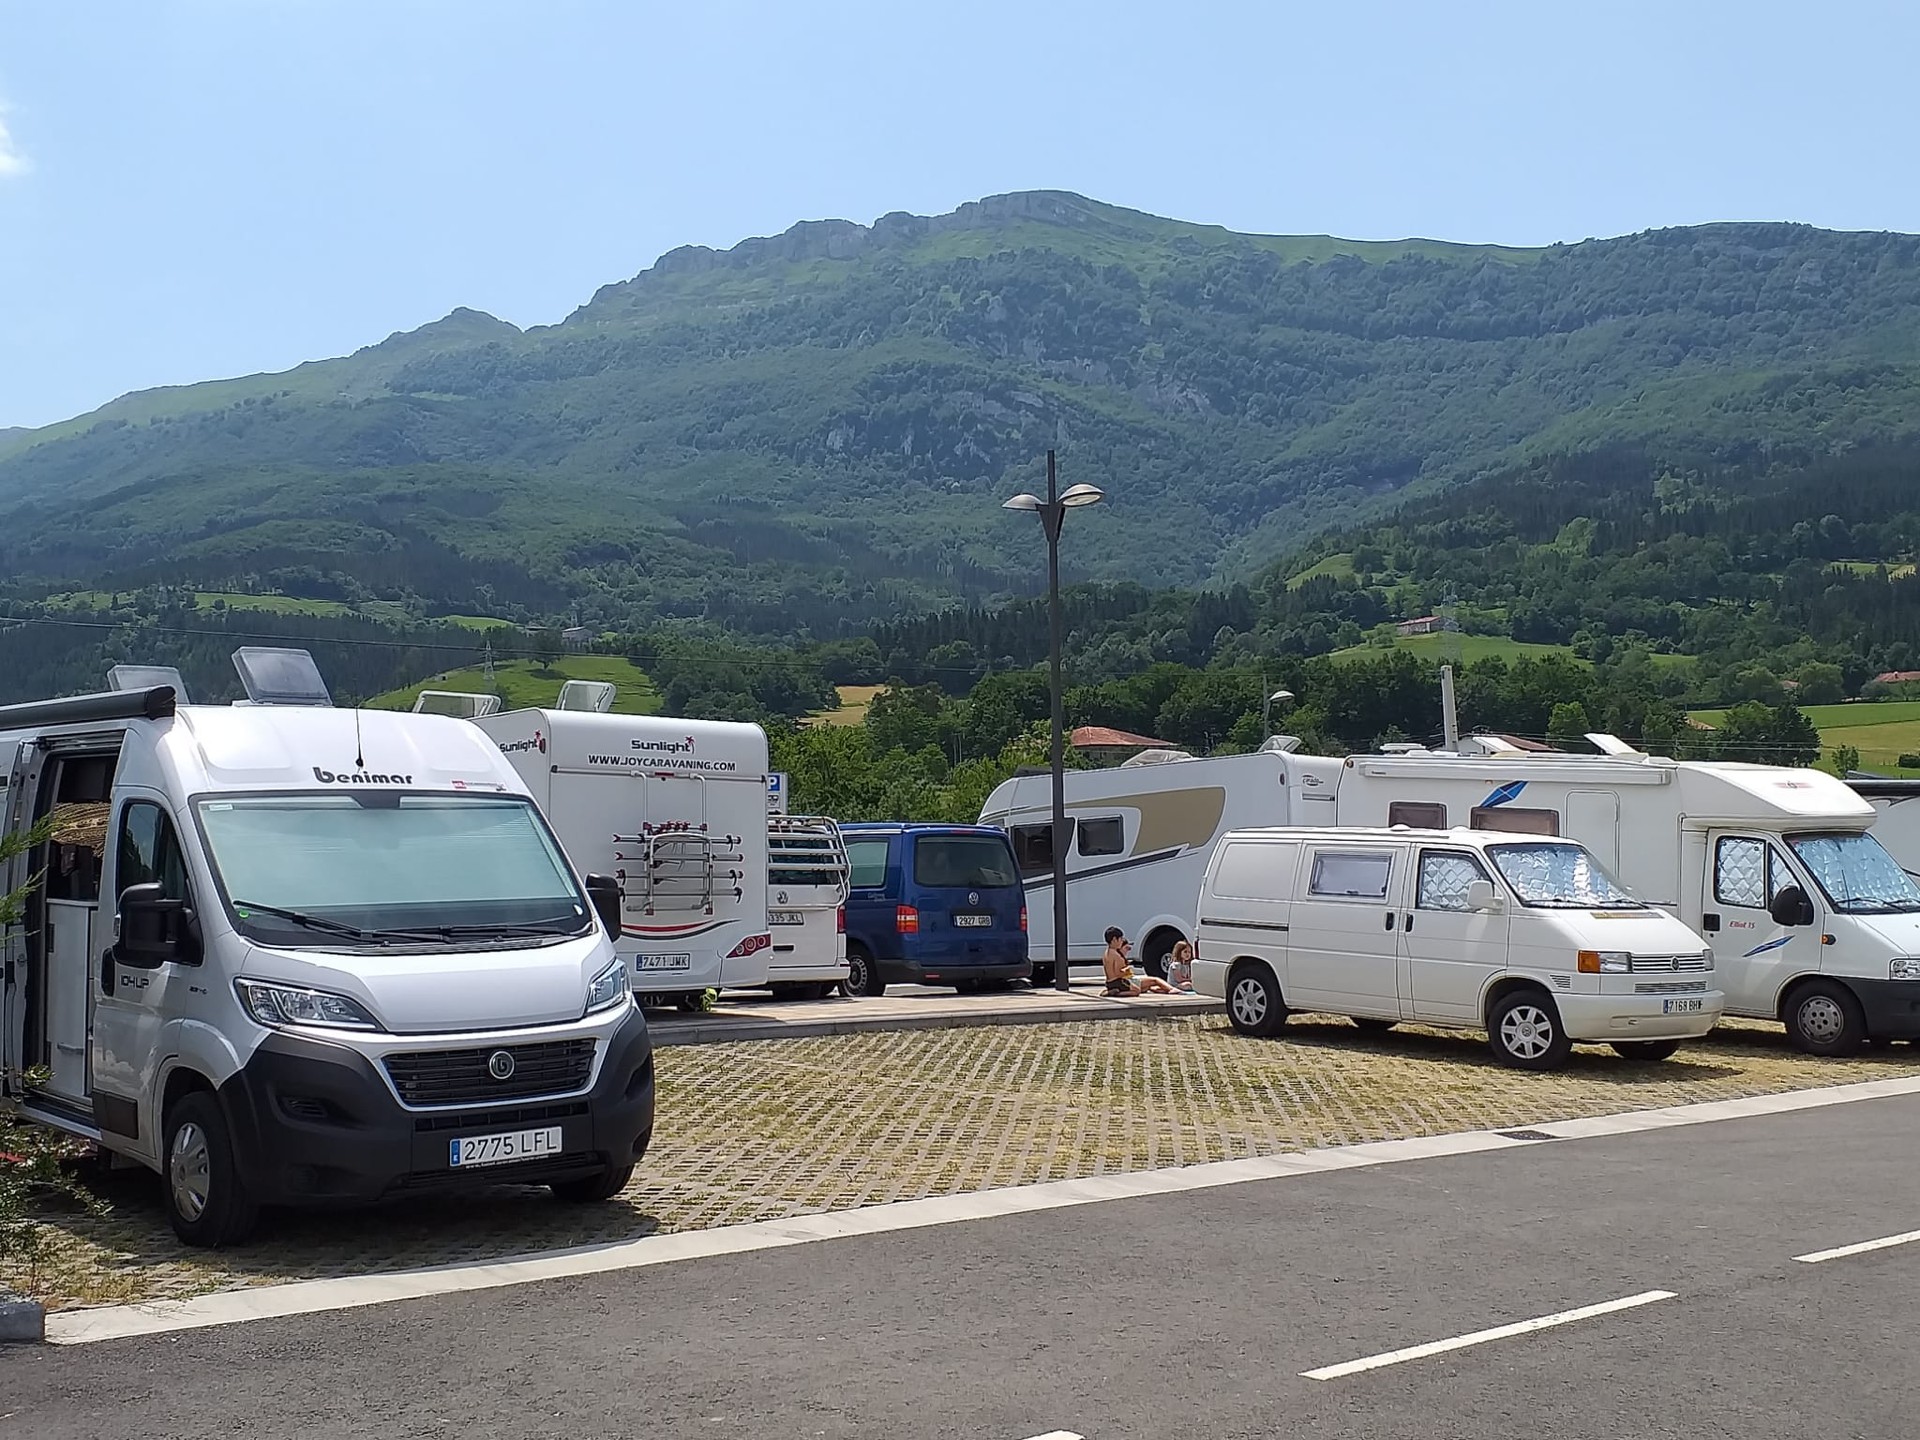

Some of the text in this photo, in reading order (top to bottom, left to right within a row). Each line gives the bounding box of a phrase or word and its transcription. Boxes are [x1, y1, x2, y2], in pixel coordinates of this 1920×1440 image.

[631, 739, 691, 754] Sunlight
[587, 754, 736, 772] WWW.JOYCARAVANING.COM
[313, 766, 413, 785] benimar
[643, 957, 666, 967] 7471
[464, 1131, 557, 1160] 2775 LFL
